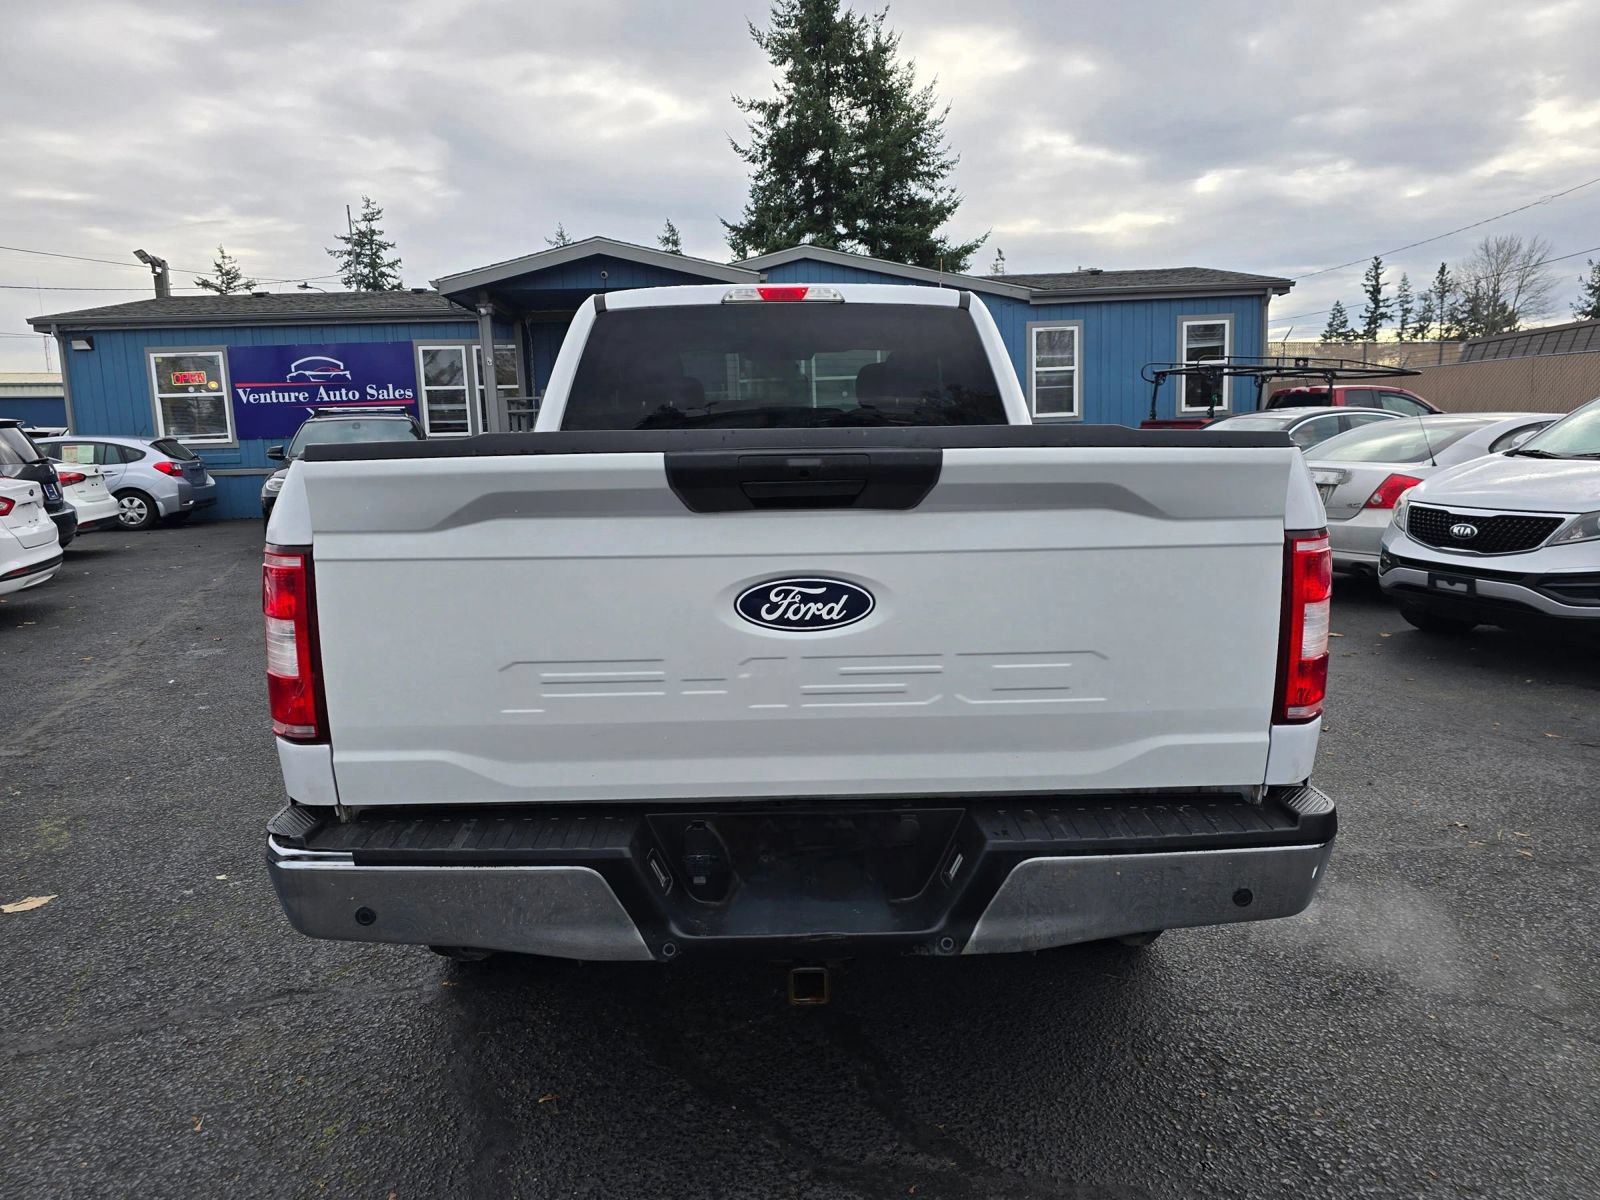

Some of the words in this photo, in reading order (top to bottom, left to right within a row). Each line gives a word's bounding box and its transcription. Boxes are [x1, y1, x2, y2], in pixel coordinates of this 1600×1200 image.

[173, 372, 205, 384] OPEN
[236, 388, 309, 404] Venture
[316, 385, 360, 402] Auto
[366, 383, 413, 400] Sales
[1452, 526, 1472, 537] KIA
[760, 585, 849, 621] Ford
